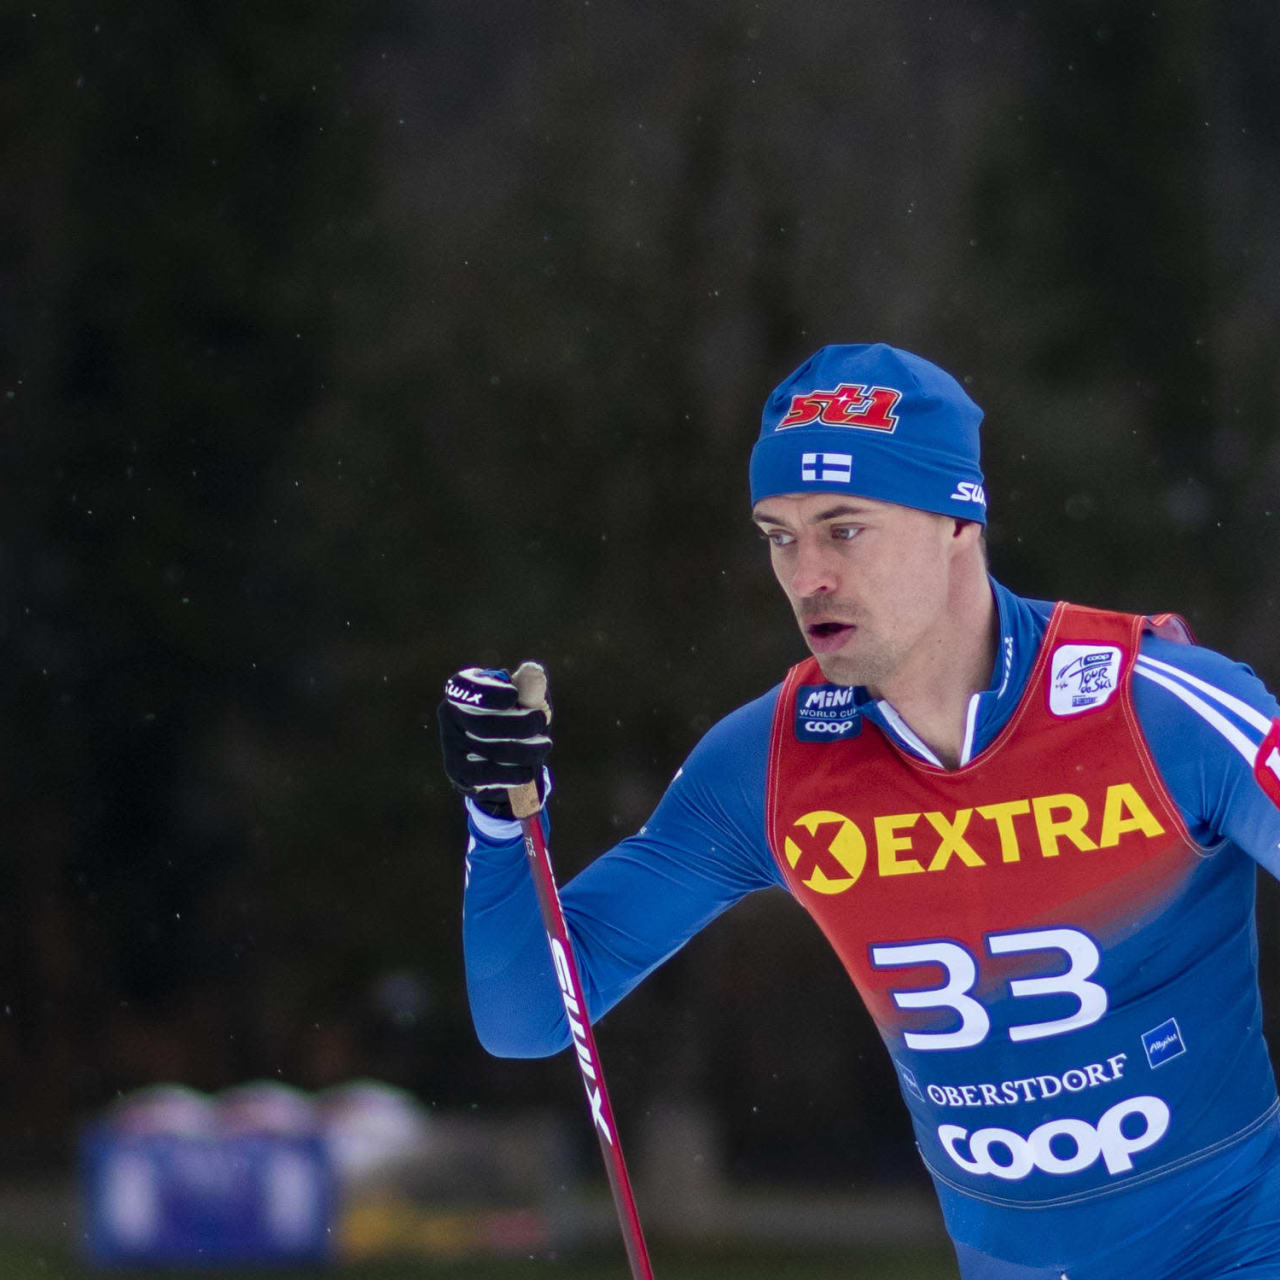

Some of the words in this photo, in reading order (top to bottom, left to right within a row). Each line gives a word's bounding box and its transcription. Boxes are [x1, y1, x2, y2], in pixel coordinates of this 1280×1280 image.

[950, 482, 986, 507] SW
[445, 680, 483, 705] WIX
[800, 709, 837, 718] WORLD
[805, 721, 853, 734] coop
[873, 782, 1166, 877] EXTRA
[871, 927, 1109, 1051] 33
[927, 1053, 1127, 1107] OBERSTDORF
[937, 1095, 1171, 1180] coop
